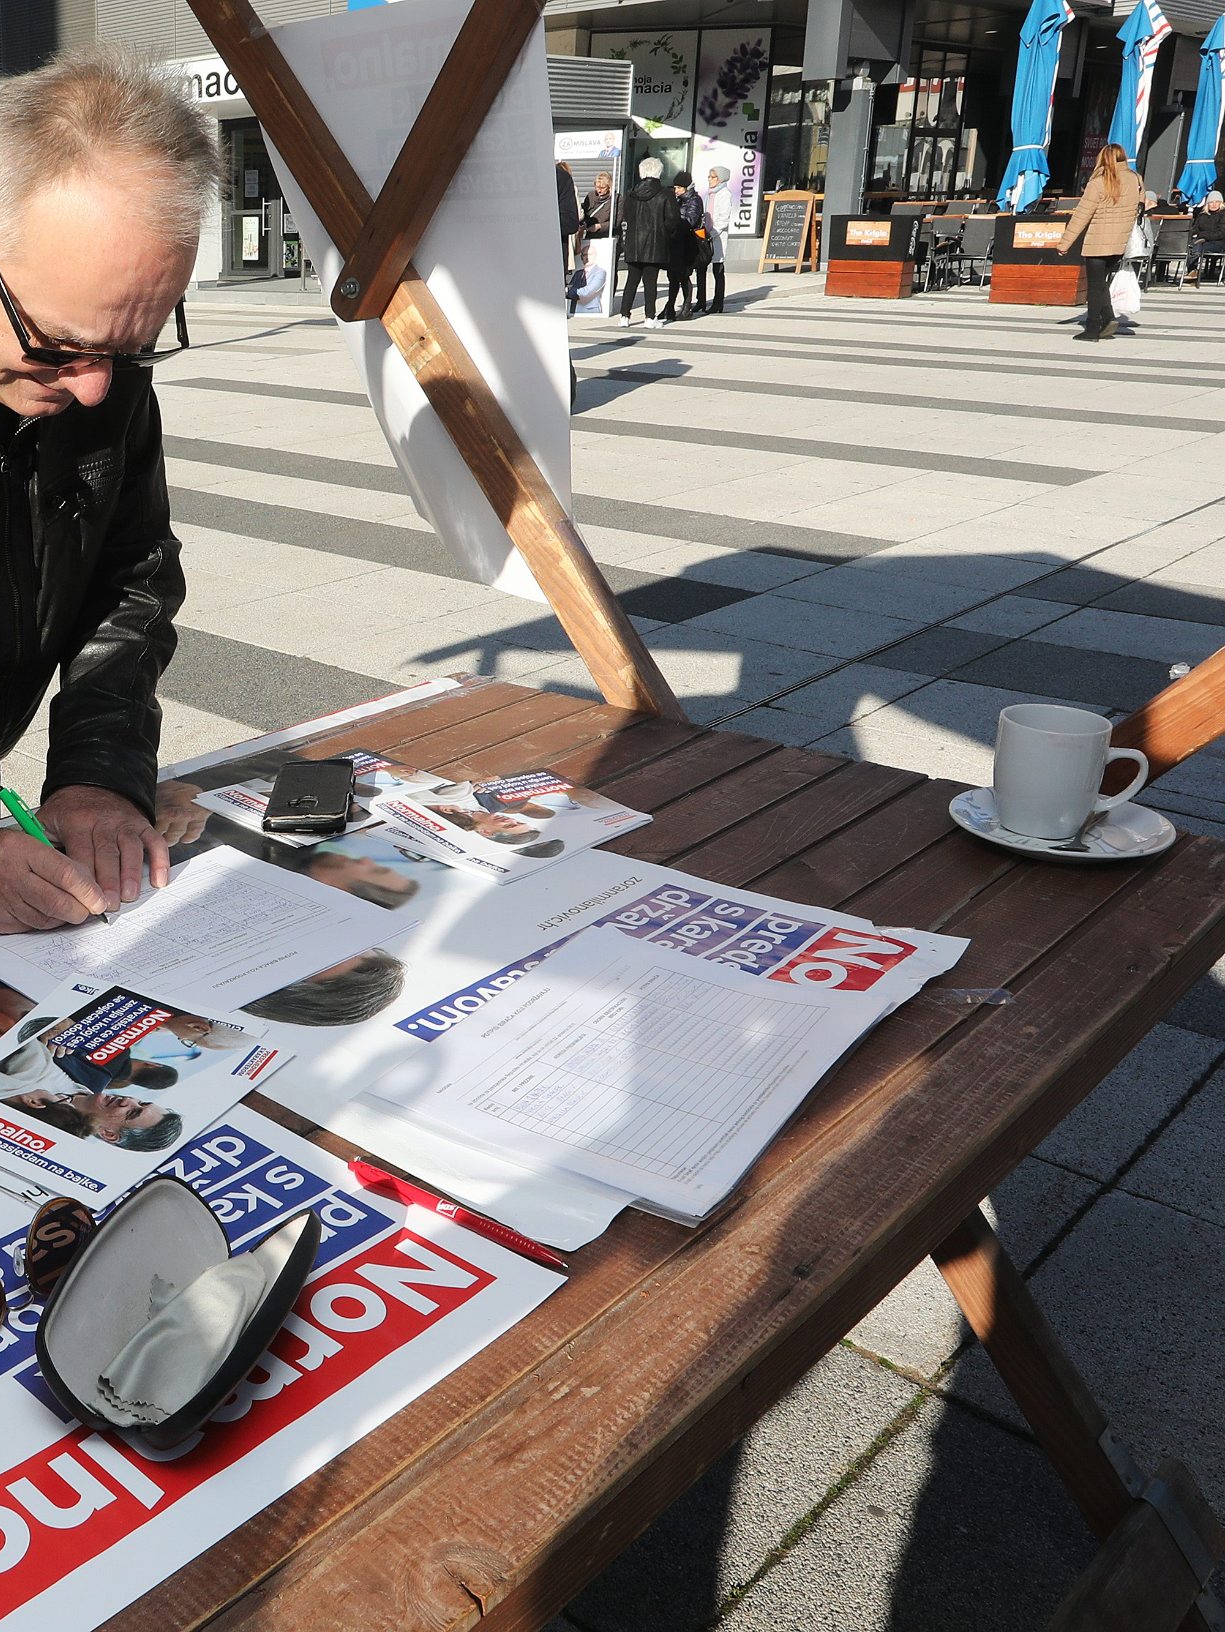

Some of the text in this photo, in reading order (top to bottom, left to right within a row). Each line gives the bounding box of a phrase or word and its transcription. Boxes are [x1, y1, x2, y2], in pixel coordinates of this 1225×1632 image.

[734, 130, 758, 229] farmacia
[536, 873, 642, 934] zoranmilanovic.hr
[49, 994, 126, 1043] se osjećati dobro!
[78, 1021, 107, 1037] kojoj
[82, 1004, 153, 1049] Hrvatska će biti
[106, 999, 141, 1019] zemlja
[62, 1035, 86, 1048] ćeš
[83, 1009, 172, 1062] Normalno,
[48, 1164, 64, 1176] na
[63, 1169, 101, 1193] bajke.
